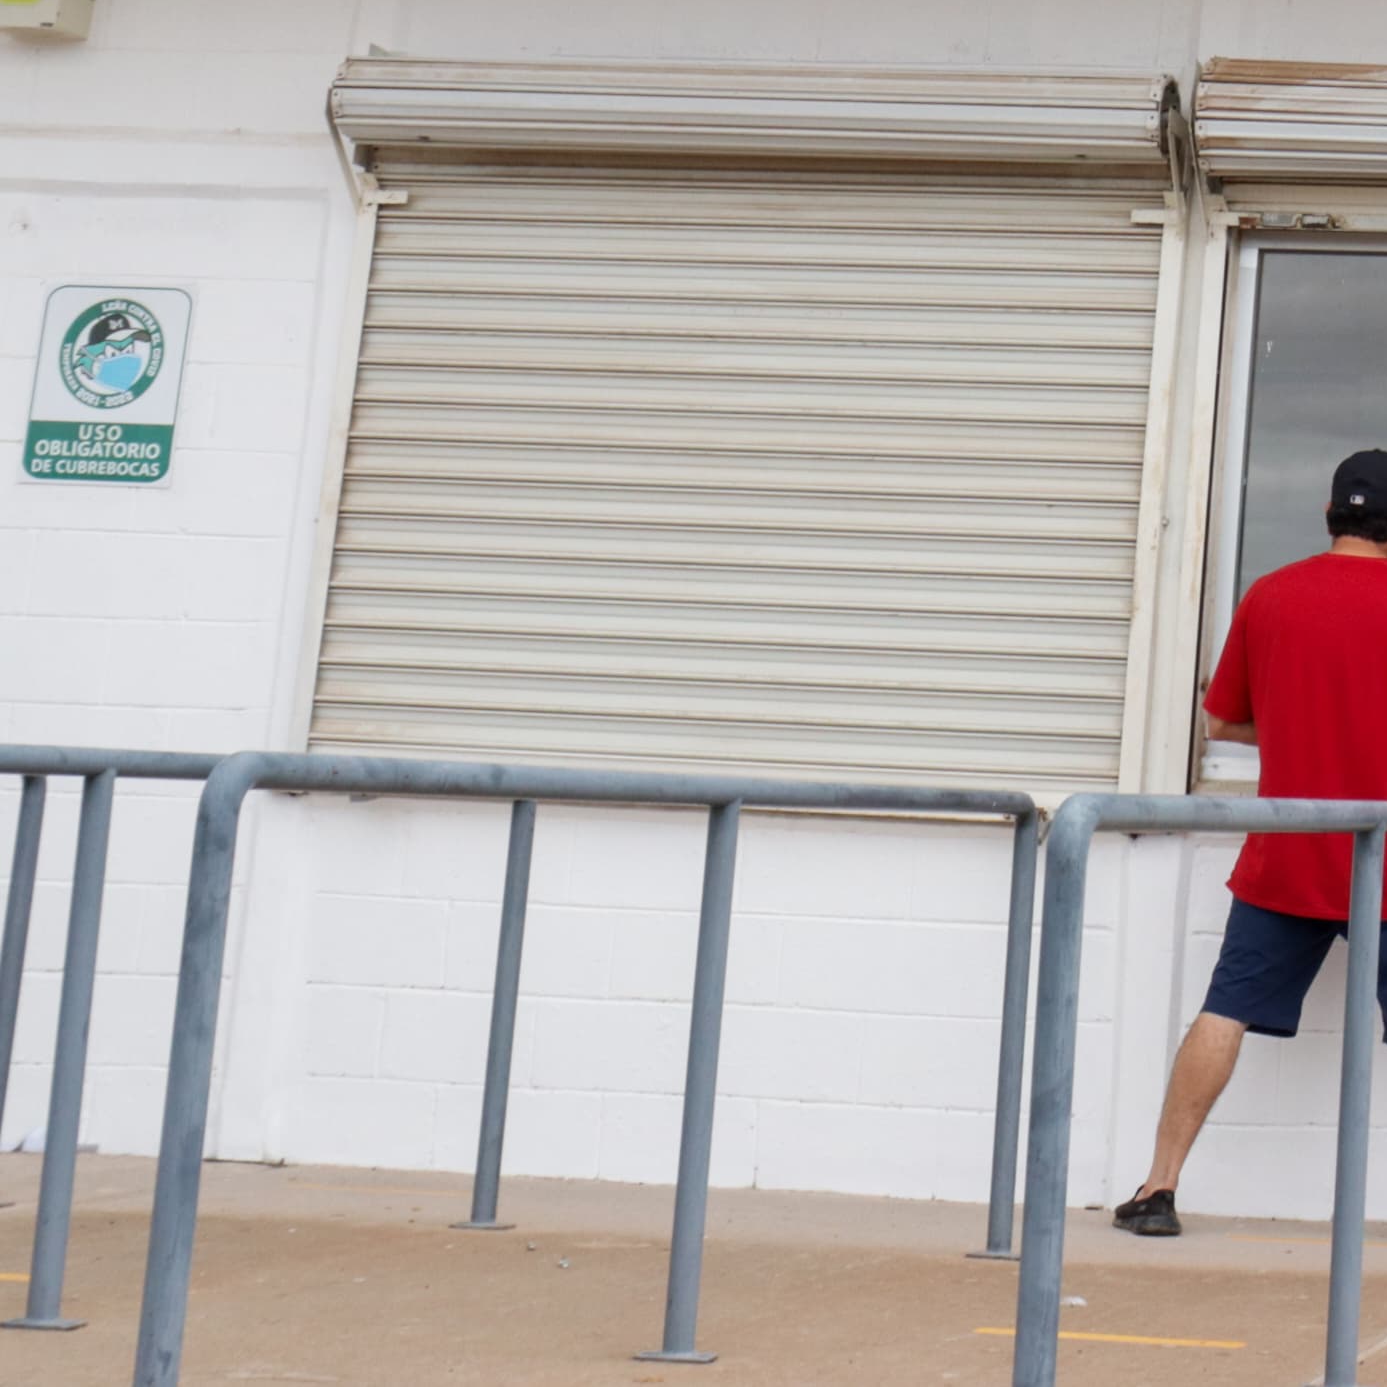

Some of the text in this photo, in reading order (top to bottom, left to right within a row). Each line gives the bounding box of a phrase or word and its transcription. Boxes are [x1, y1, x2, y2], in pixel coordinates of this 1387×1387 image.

[79, 425, 122, 441] USO
[35, 440, 161, 459] OBLIGATORIO
[31, 458, 160, 477] DE CUBREBOCAS
